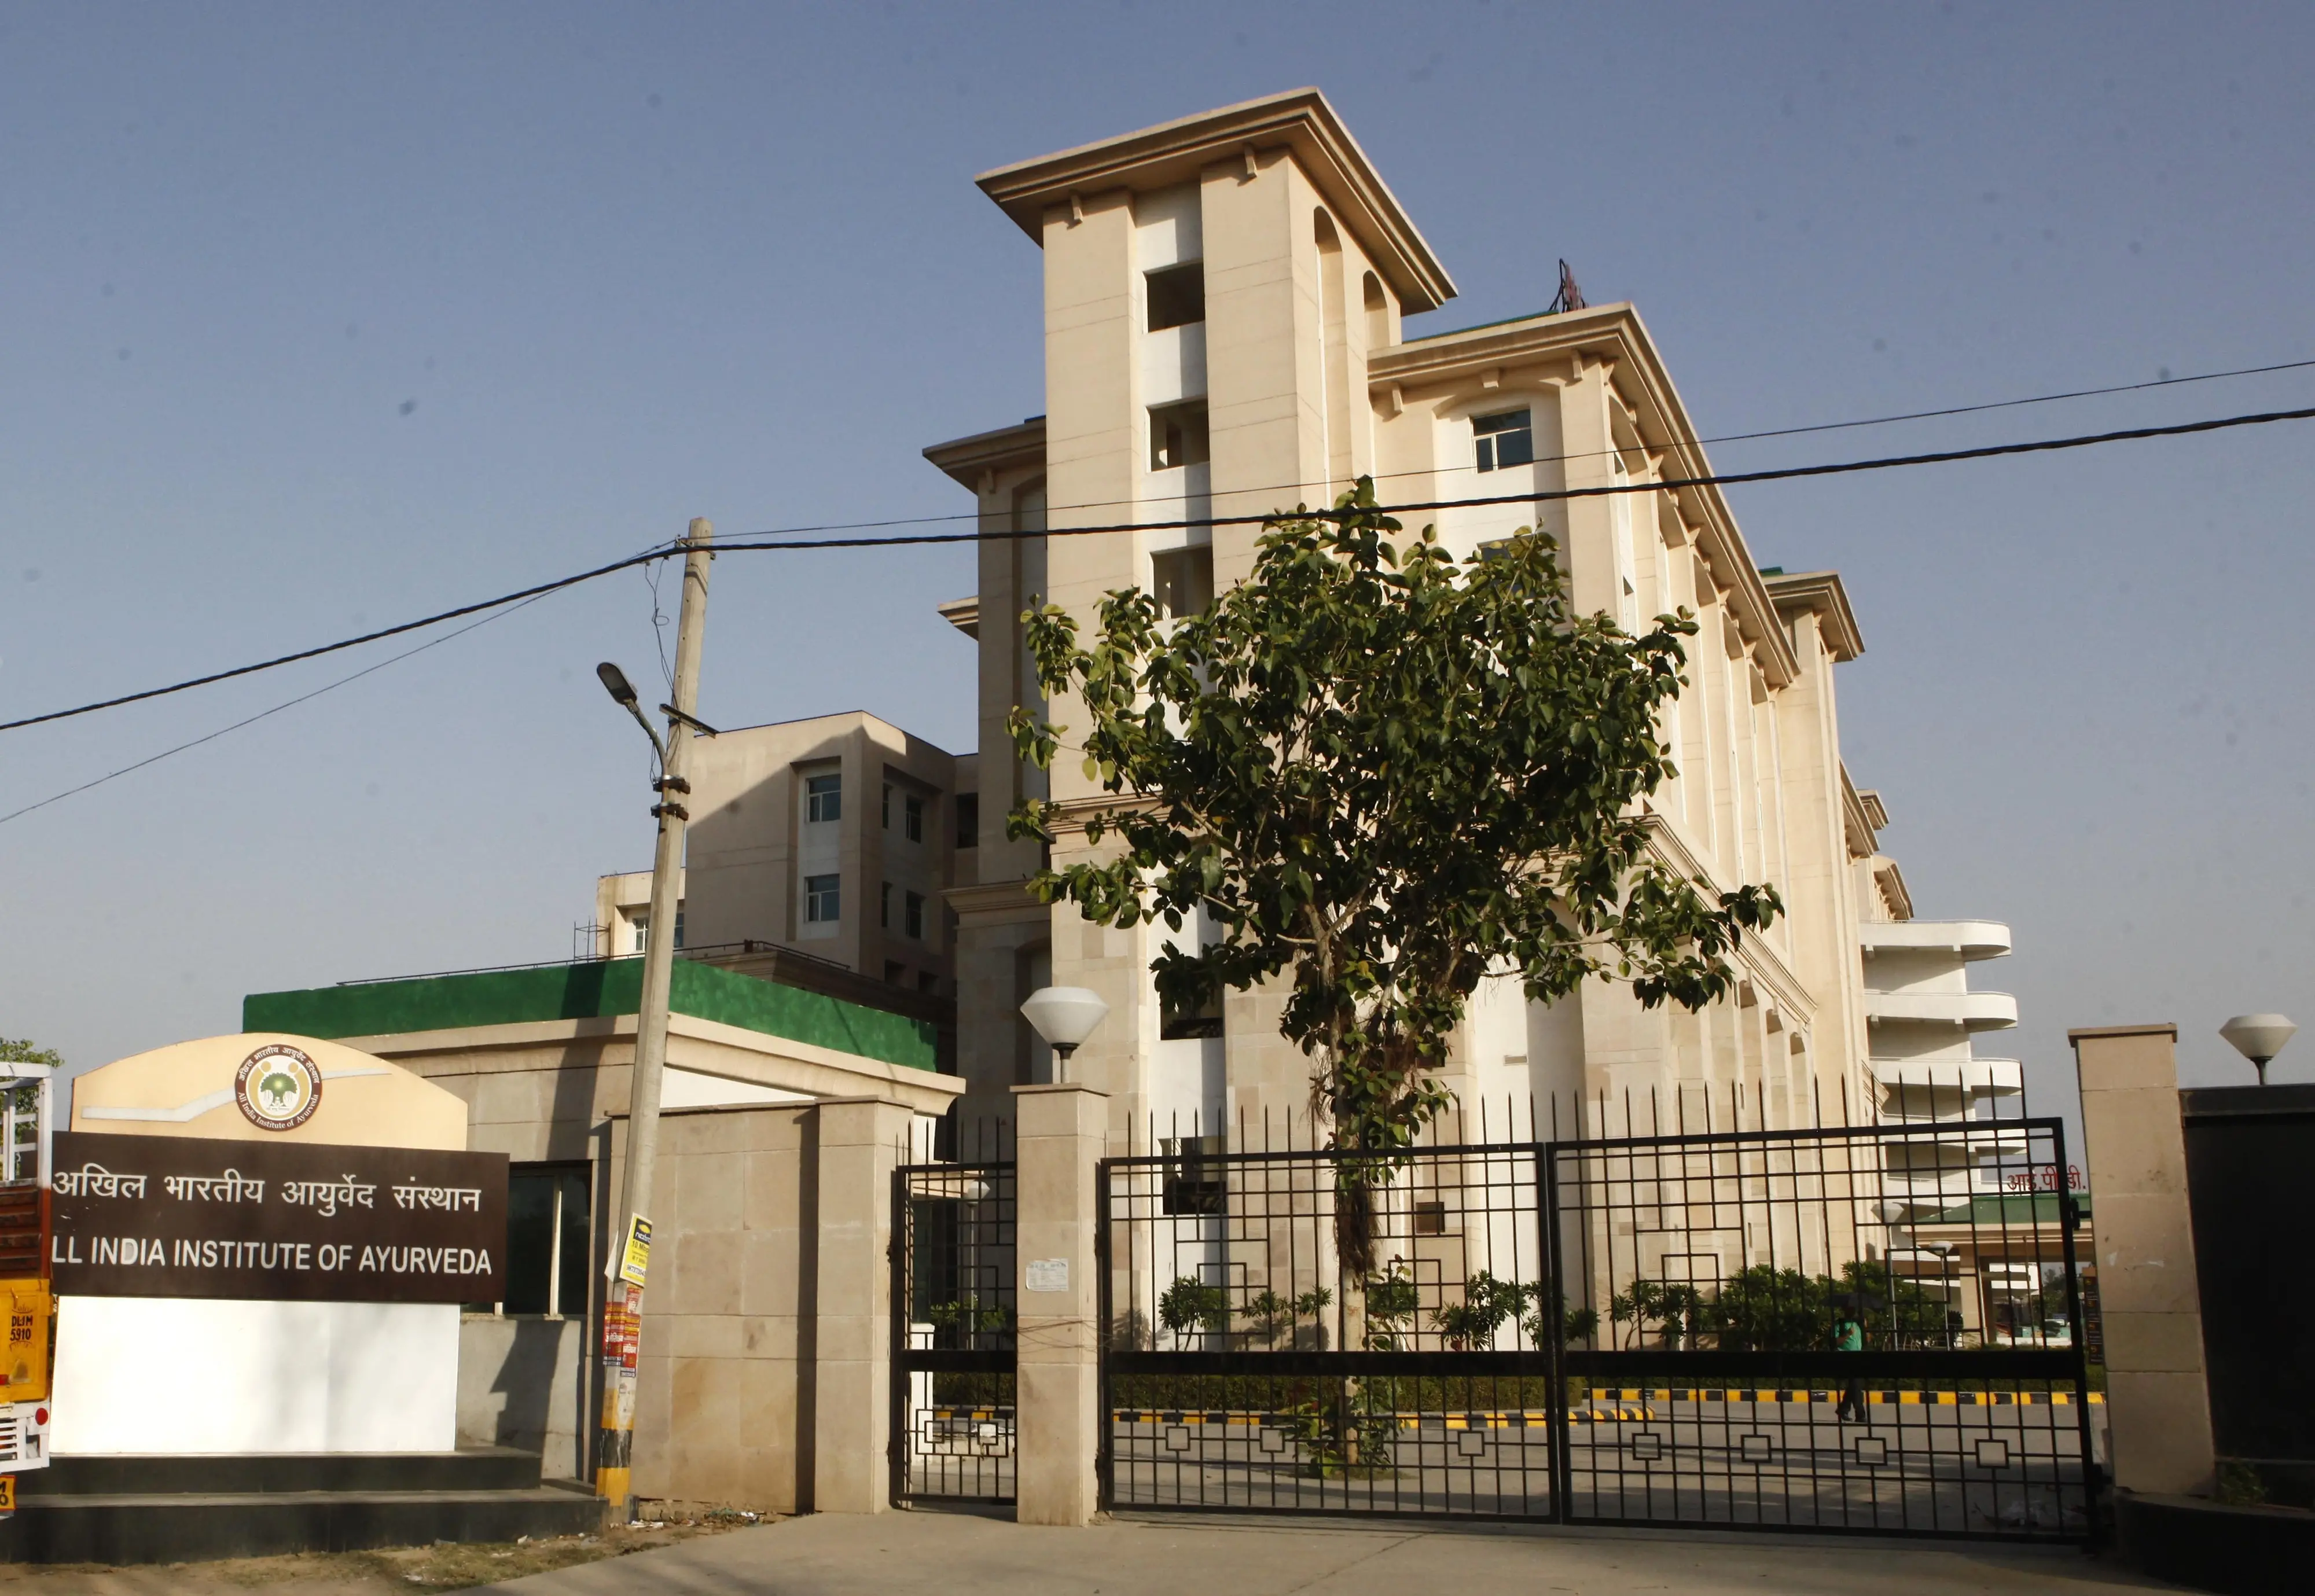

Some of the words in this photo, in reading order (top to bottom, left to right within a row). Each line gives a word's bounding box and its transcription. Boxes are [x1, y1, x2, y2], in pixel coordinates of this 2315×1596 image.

[238, 1092, 247, 1102] All
[242, 1101, 256, 1120] India
[297, 1094, 319, 1123] Ayurveda
[256, 1117, 286, 1128] Institute
[287, 1119, 294, 1127] of
[52, 1163, 147, 1199] अखिल
[164, 1168, 266, 1204] भारतीय
[281, 1174, 377, 1216] आयुर्वेद
[392, 1176, 482, 1212] संस्थान
[52, 1235, 83, 1263] LL
[91, 1237, 166, 1266] INDIA
[175, 1239, 311, 1270] INSTITUTE
[318, 1244, 353, 1271] OF
[358, 1245, 493, 1275] AYURVEDA
[10, 1328, 32, 1341] 5910
